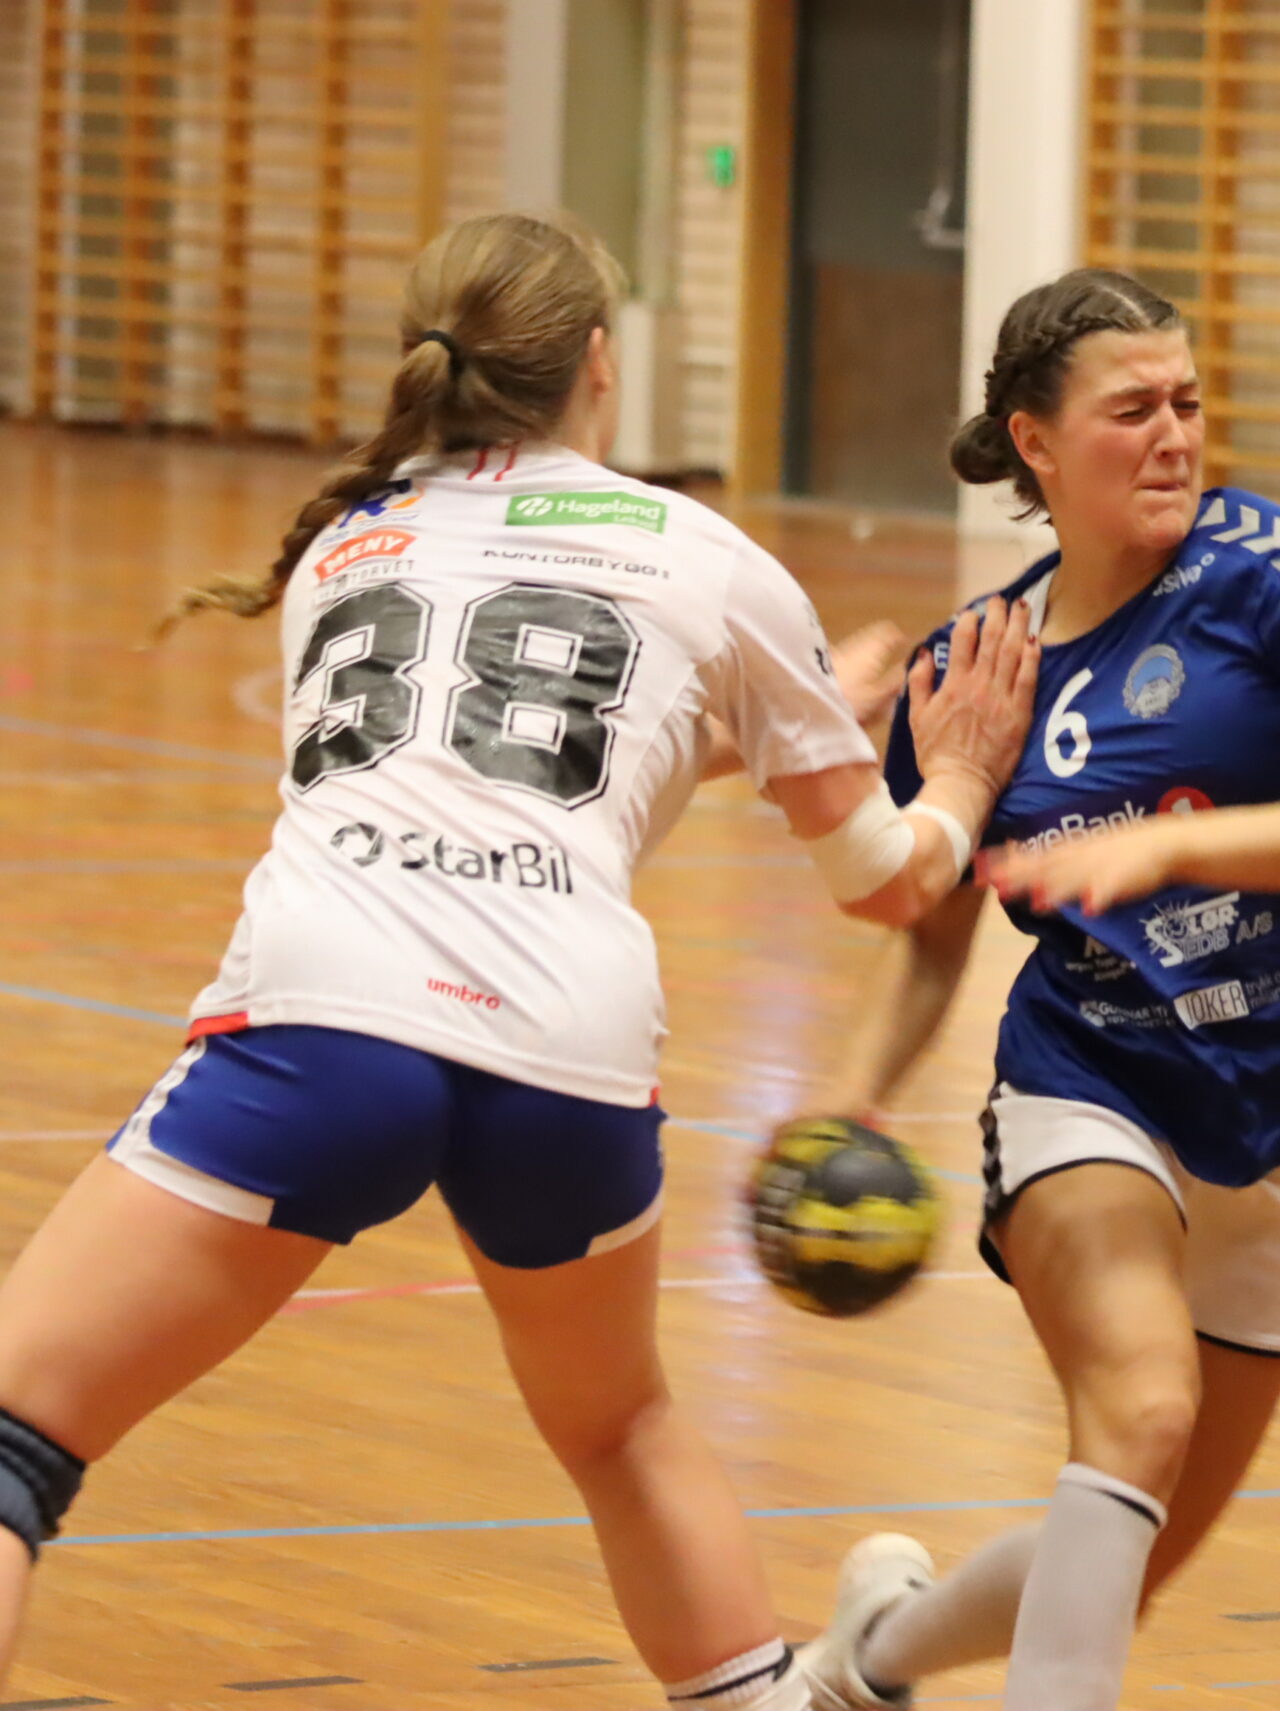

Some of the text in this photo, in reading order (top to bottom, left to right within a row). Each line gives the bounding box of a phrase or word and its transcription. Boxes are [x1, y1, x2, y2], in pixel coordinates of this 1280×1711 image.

[556, 498, 661, 520] Hageland
[323, 535, 404, 574] MENY
[290, 580, 643, 812] 38
[1043, 667, 1093, 779] 6
[1020, 800, 1146, 857] areBank
[400, 832, 573, 895] StarBil
[1236, 910, 1274, 944] A/S
[427, 977, 501, 1010] umbro
[1183, 982, 1249, 1027] JOKER
